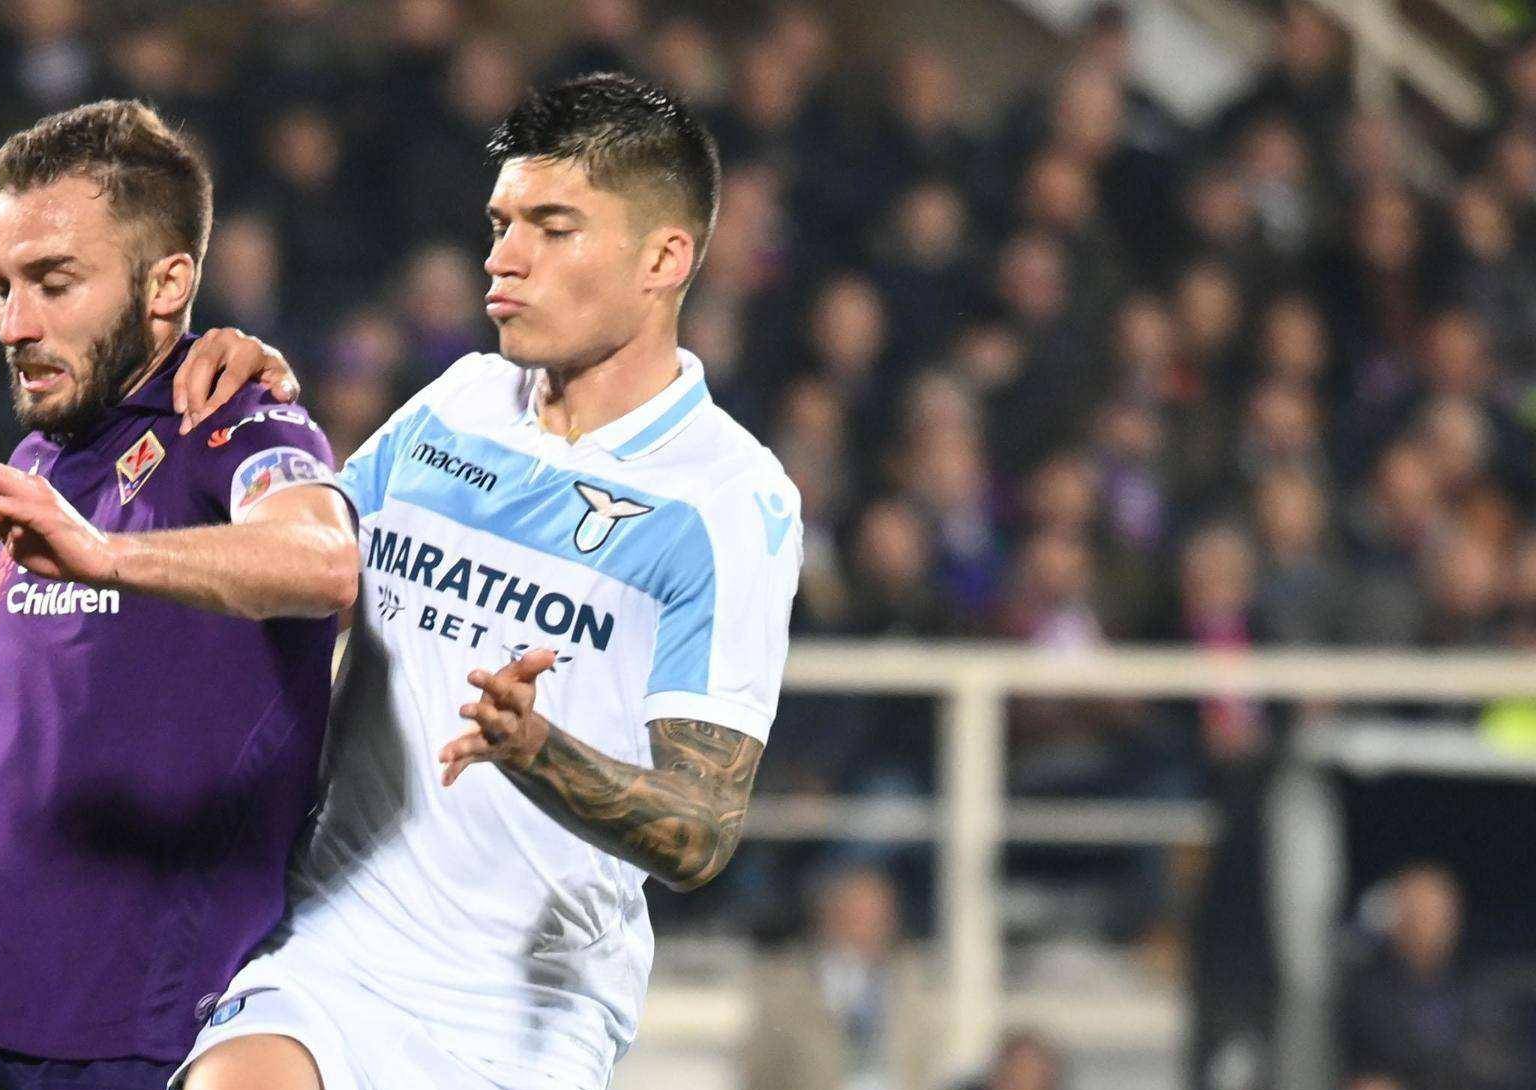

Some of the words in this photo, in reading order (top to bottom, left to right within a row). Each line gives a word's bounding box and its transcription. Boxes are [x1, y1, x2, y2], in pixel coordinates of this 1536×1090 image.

[411, 443, 497, 492] macron
[6, 581, 121, 616] Children
[366, 526, 615, 652] MARATHON
[418, 605, 490, 650] BET
